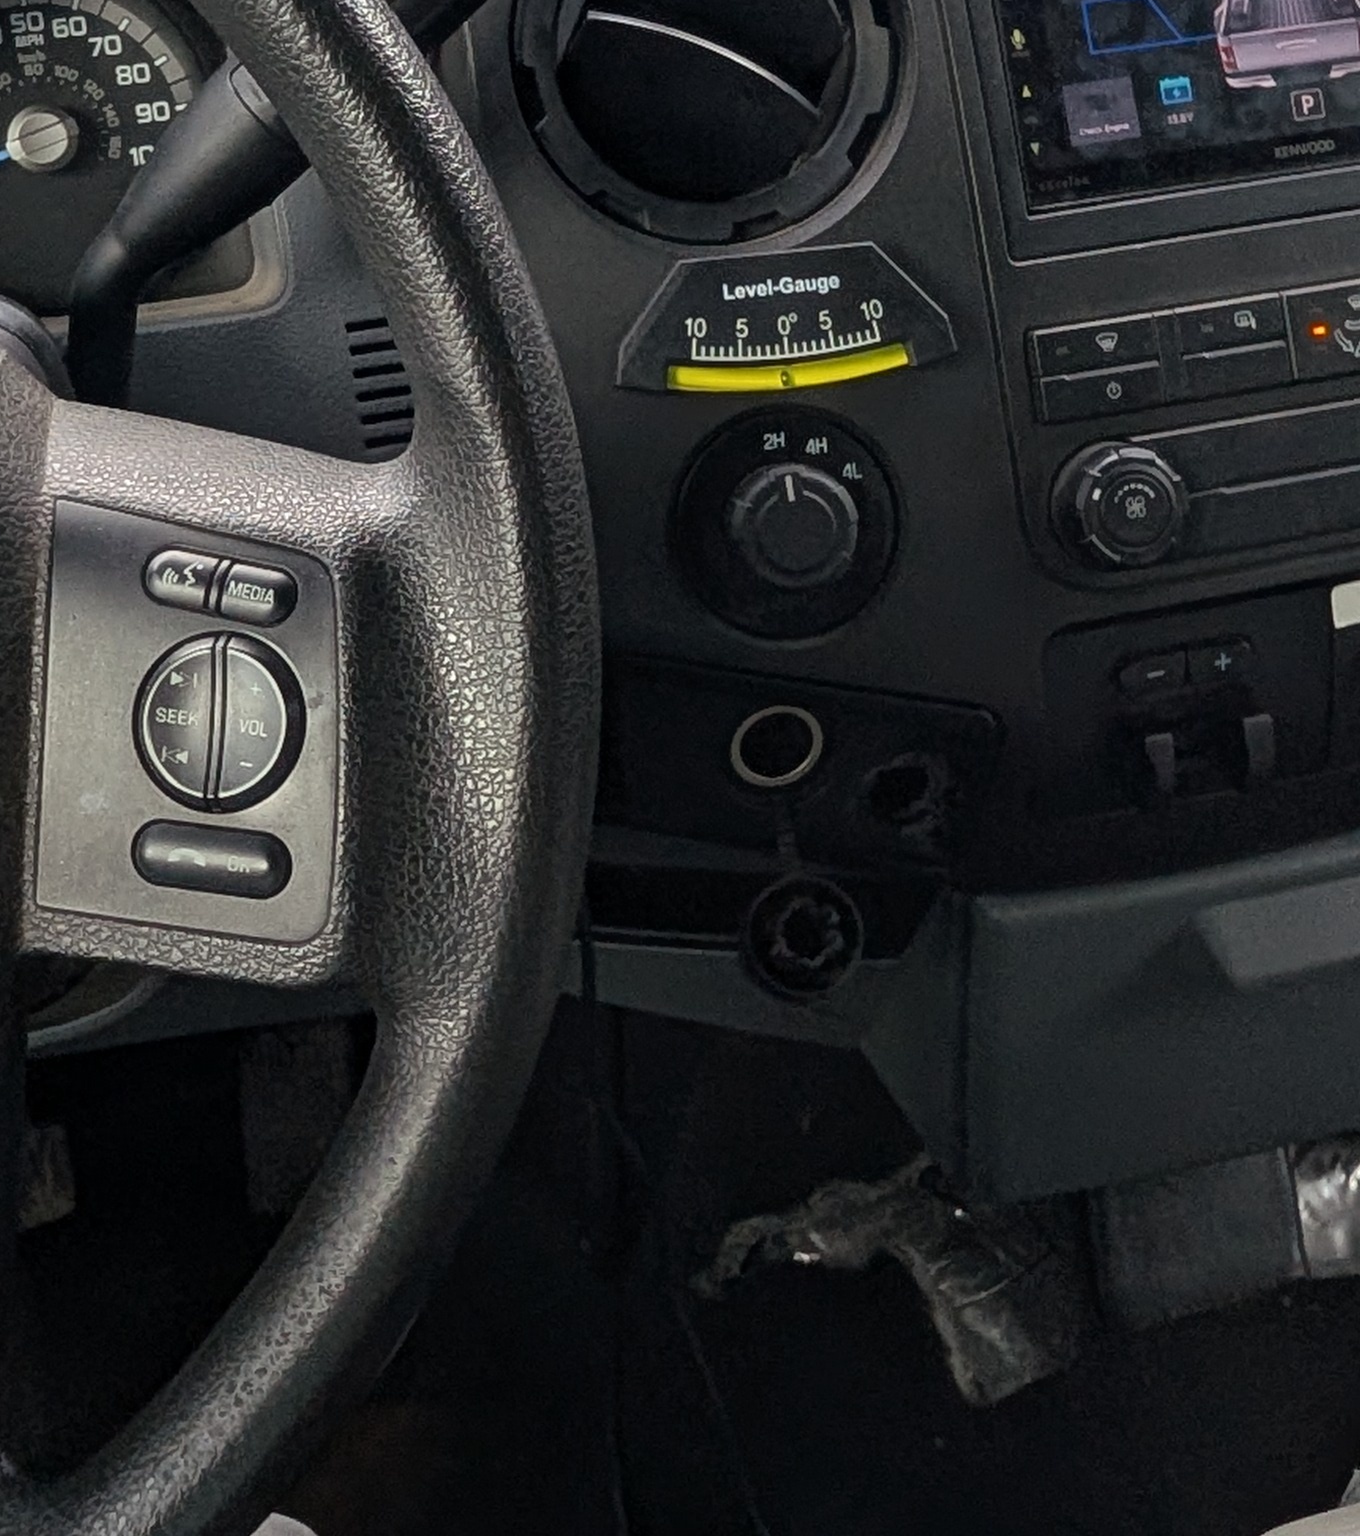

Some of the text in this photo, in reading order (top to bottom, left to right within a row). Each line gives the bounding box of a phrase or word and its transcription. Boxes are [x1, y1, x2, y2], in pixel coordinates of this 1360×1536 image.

[10, 11, 44, 34] 50
[52, 16, 87, 38] 60
[15, 34, 44, 47] MPH
[88, 35, 122, 57] 70
[54, 65, 79, 81] 100
[115, 63, 151, 85] 80
[84, 79, 105, 100] 120
[135, 101, 171, 124] 90
[1274, 139, 1336, 159] KENWOOD
[722, 274, 840, 301] Level-Gauge
[685, 317, 707, 338] 10
[735, 318, 749, 338] 5
[819, 310, 833, 331] 5
[860, 299, 883, 321] 10
[763, 431, 828, 454] 2H 4H
[842, 462, 862, 480] 4L
[227, 580, 275, 605] MEDIA
[155, 707, 199, 727] SEEK
[240, 720, 268, 739] VOL
